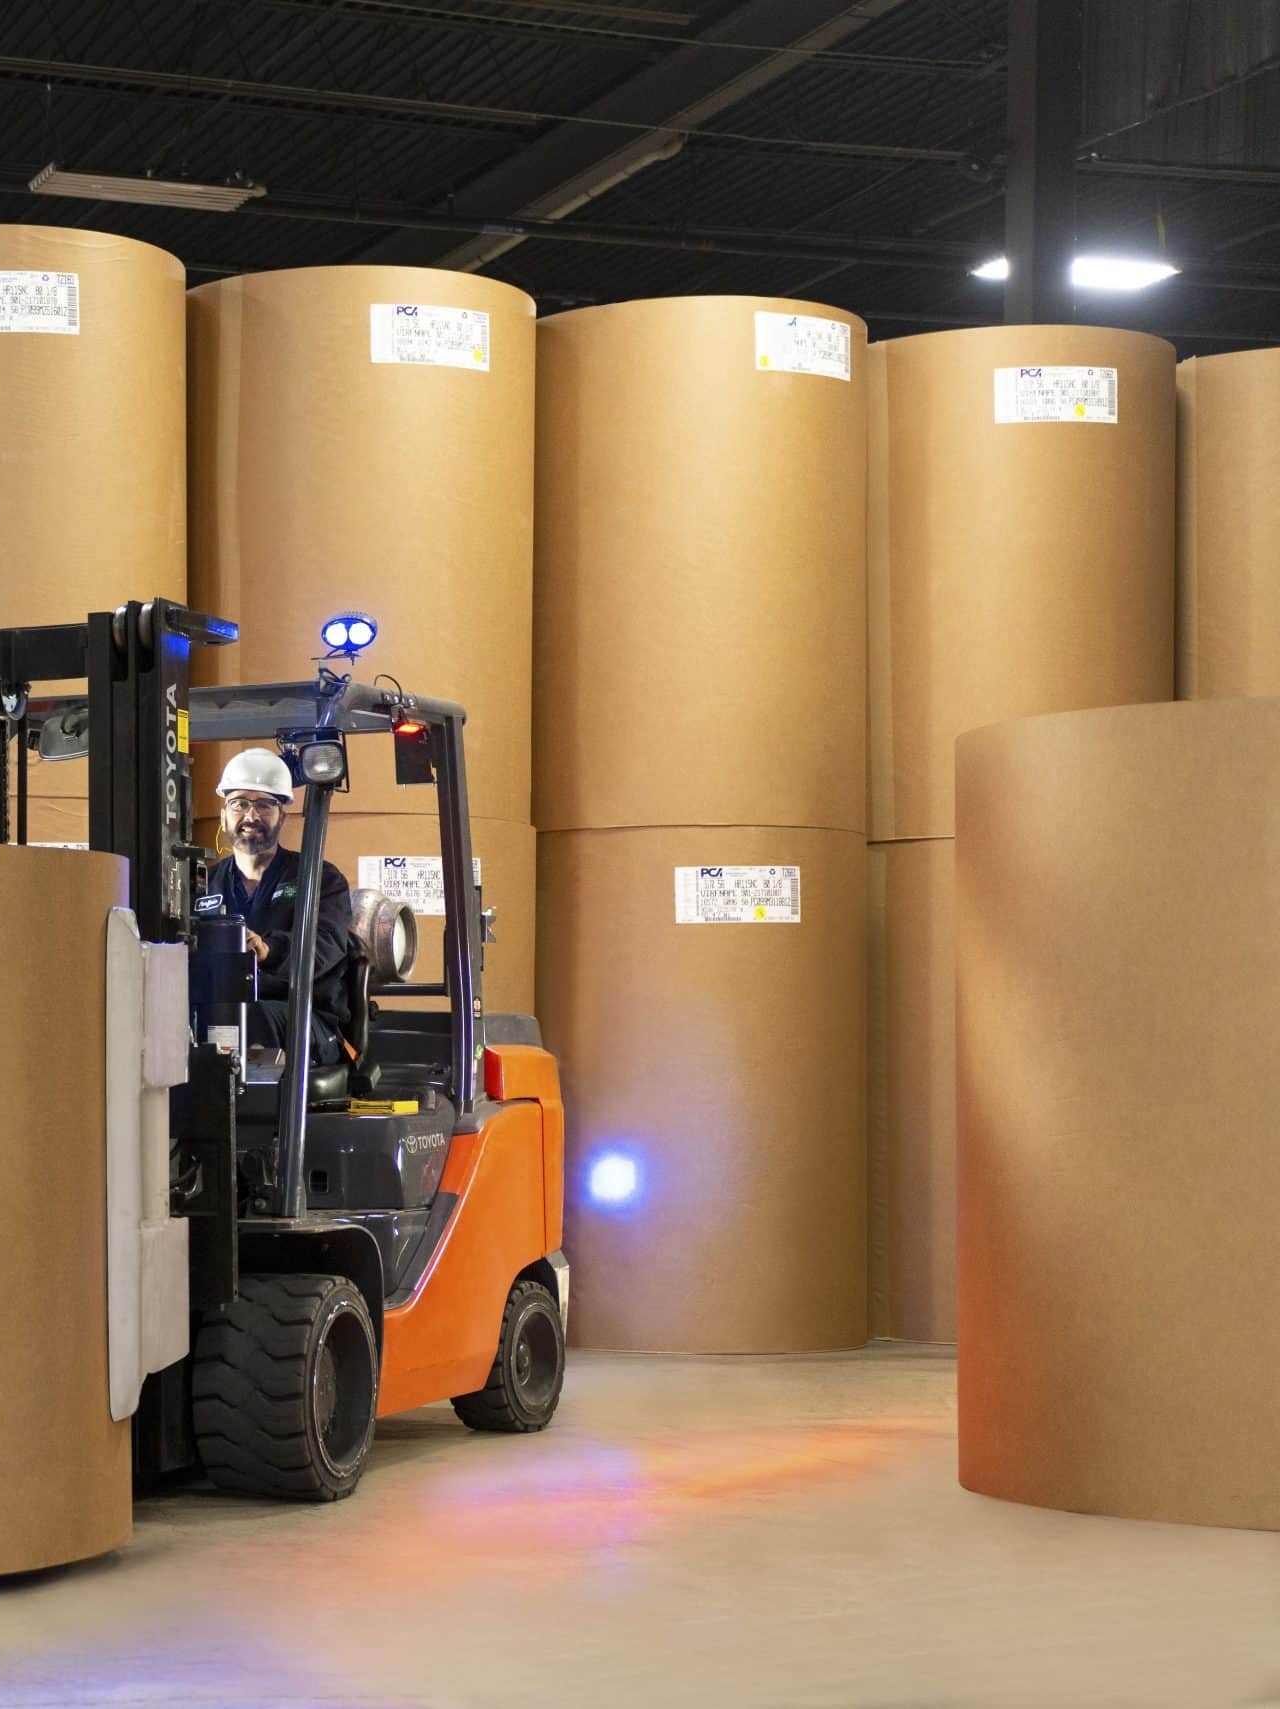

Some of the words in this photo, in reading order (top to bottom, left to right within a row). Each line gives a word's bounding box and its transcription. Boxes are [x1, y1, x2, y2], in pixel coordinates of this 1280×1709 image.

[397, 306, 418, 316] PCA
[1021, 368, 1042, 378] PCA
[166, 683, 177, 824] TOYOTA
[384, 858, 406, 867] PCA
[700, 868, 722, 878] PCA
[417, 1133, 446, 1150] TOYOTA
